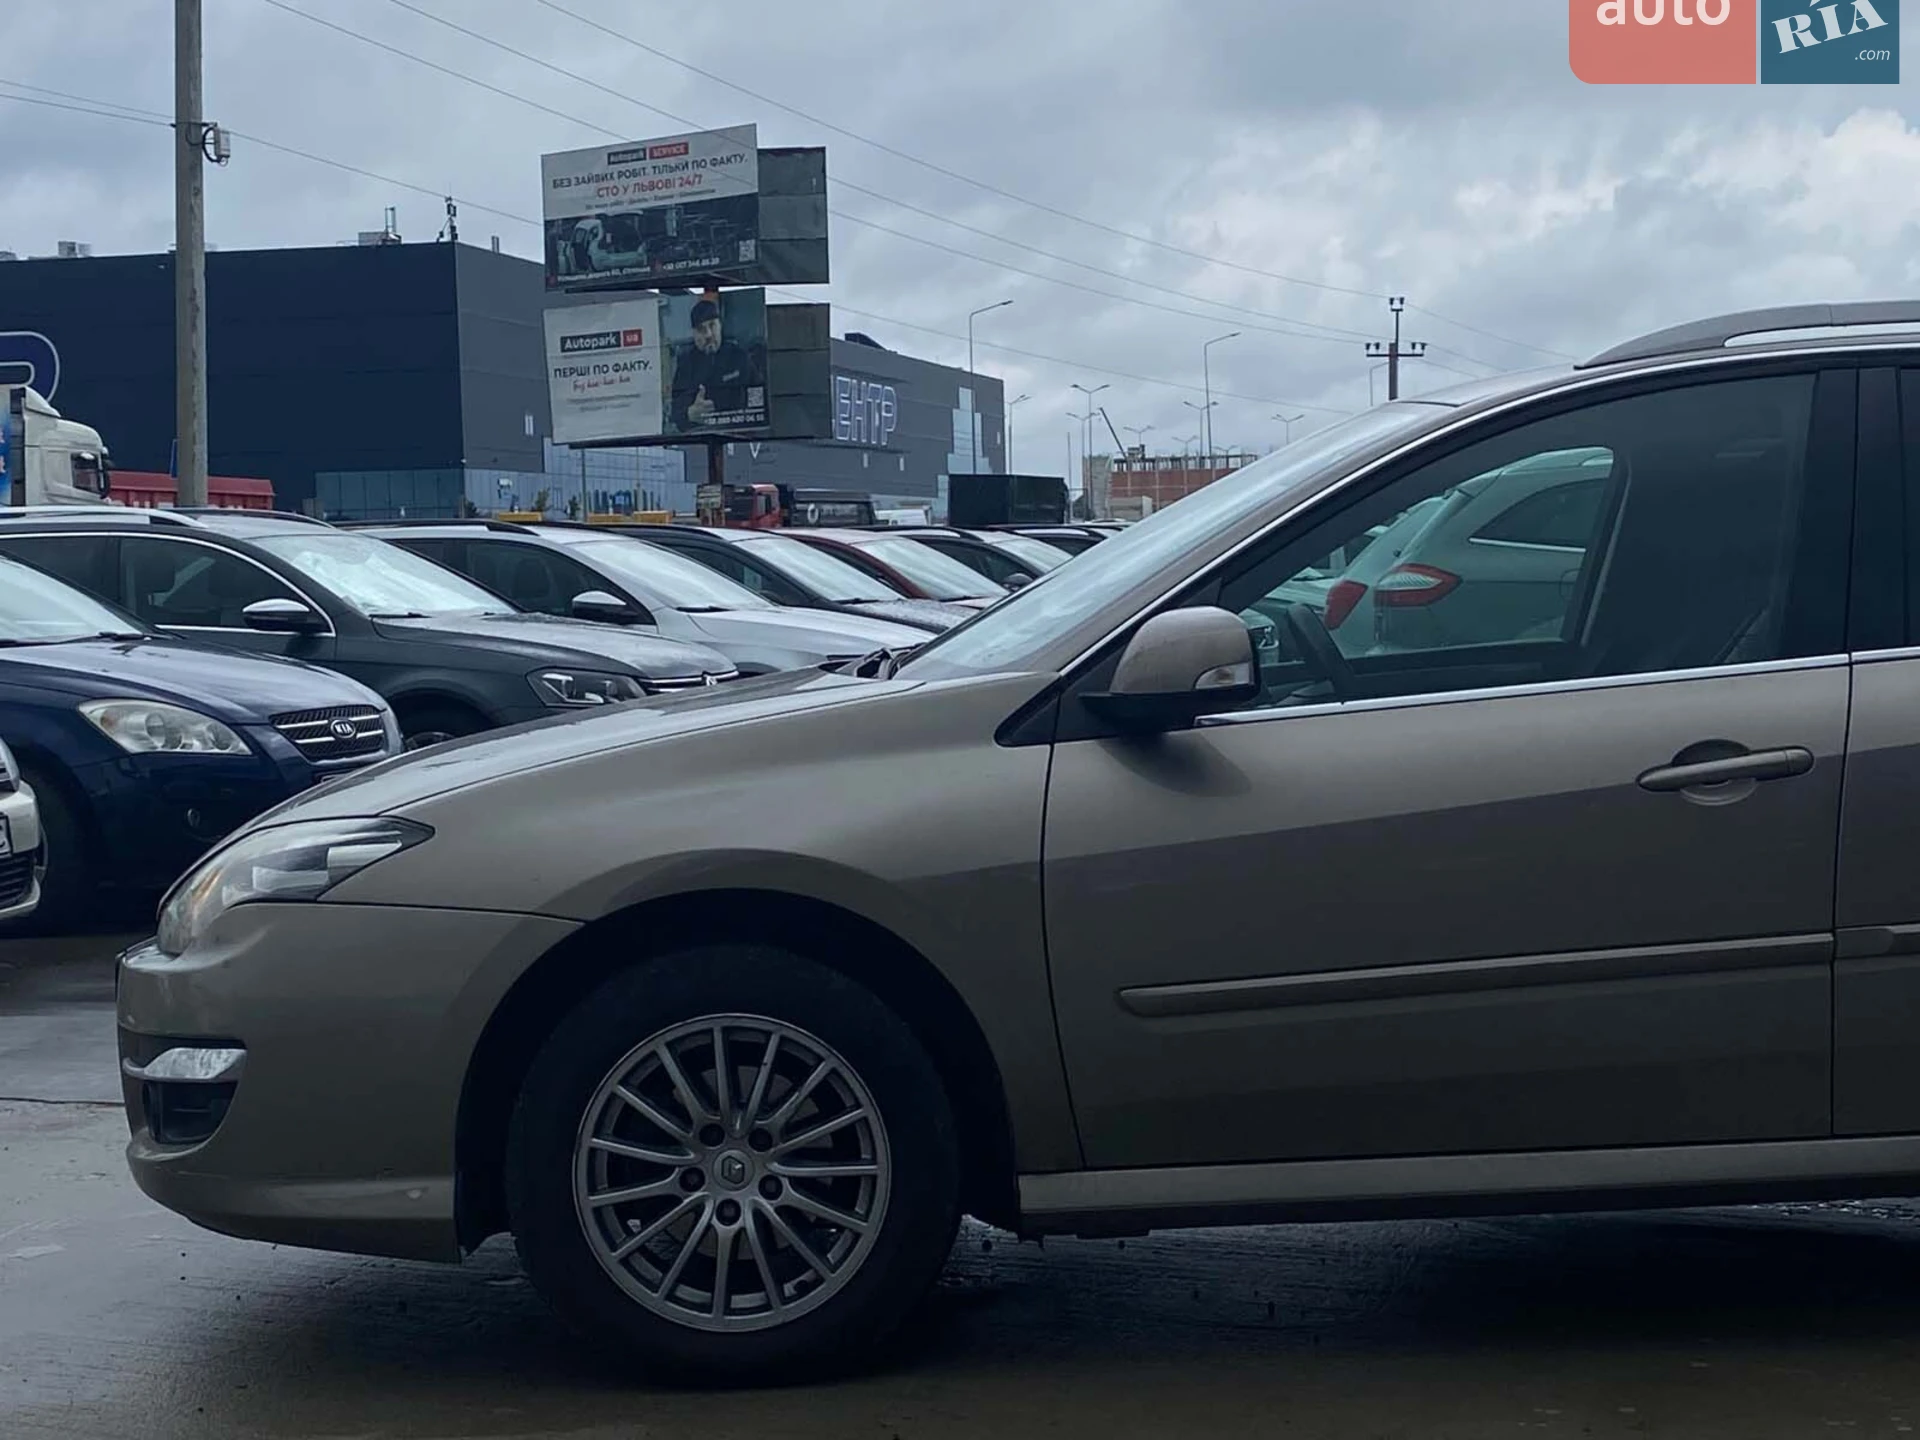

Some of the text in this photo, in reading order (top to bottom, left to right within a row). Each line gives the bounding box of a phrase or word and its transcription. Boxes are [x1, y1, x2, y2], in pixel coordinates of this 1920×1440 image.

[552, 178, 571, 189] БЕЗ
[573, 171, 616, 187] ЗАЙВИХ
[651, 161, 689, 178] ТІЛЬКИ
[691, 158, 708, 171] ПО
[709, 153, 748, 168] ФАКТУ.
[596, 173, 703, 198] СТО У ЛЬВОВІ 24/7
[564, 333, 639, 350] Autopark ua
[554, 360, 653, 379] ПЕРШІ ПО ФАКТУ.
[830, 375, 898, 446] ЕНТР
[334, 723, 353, 734] KIA
